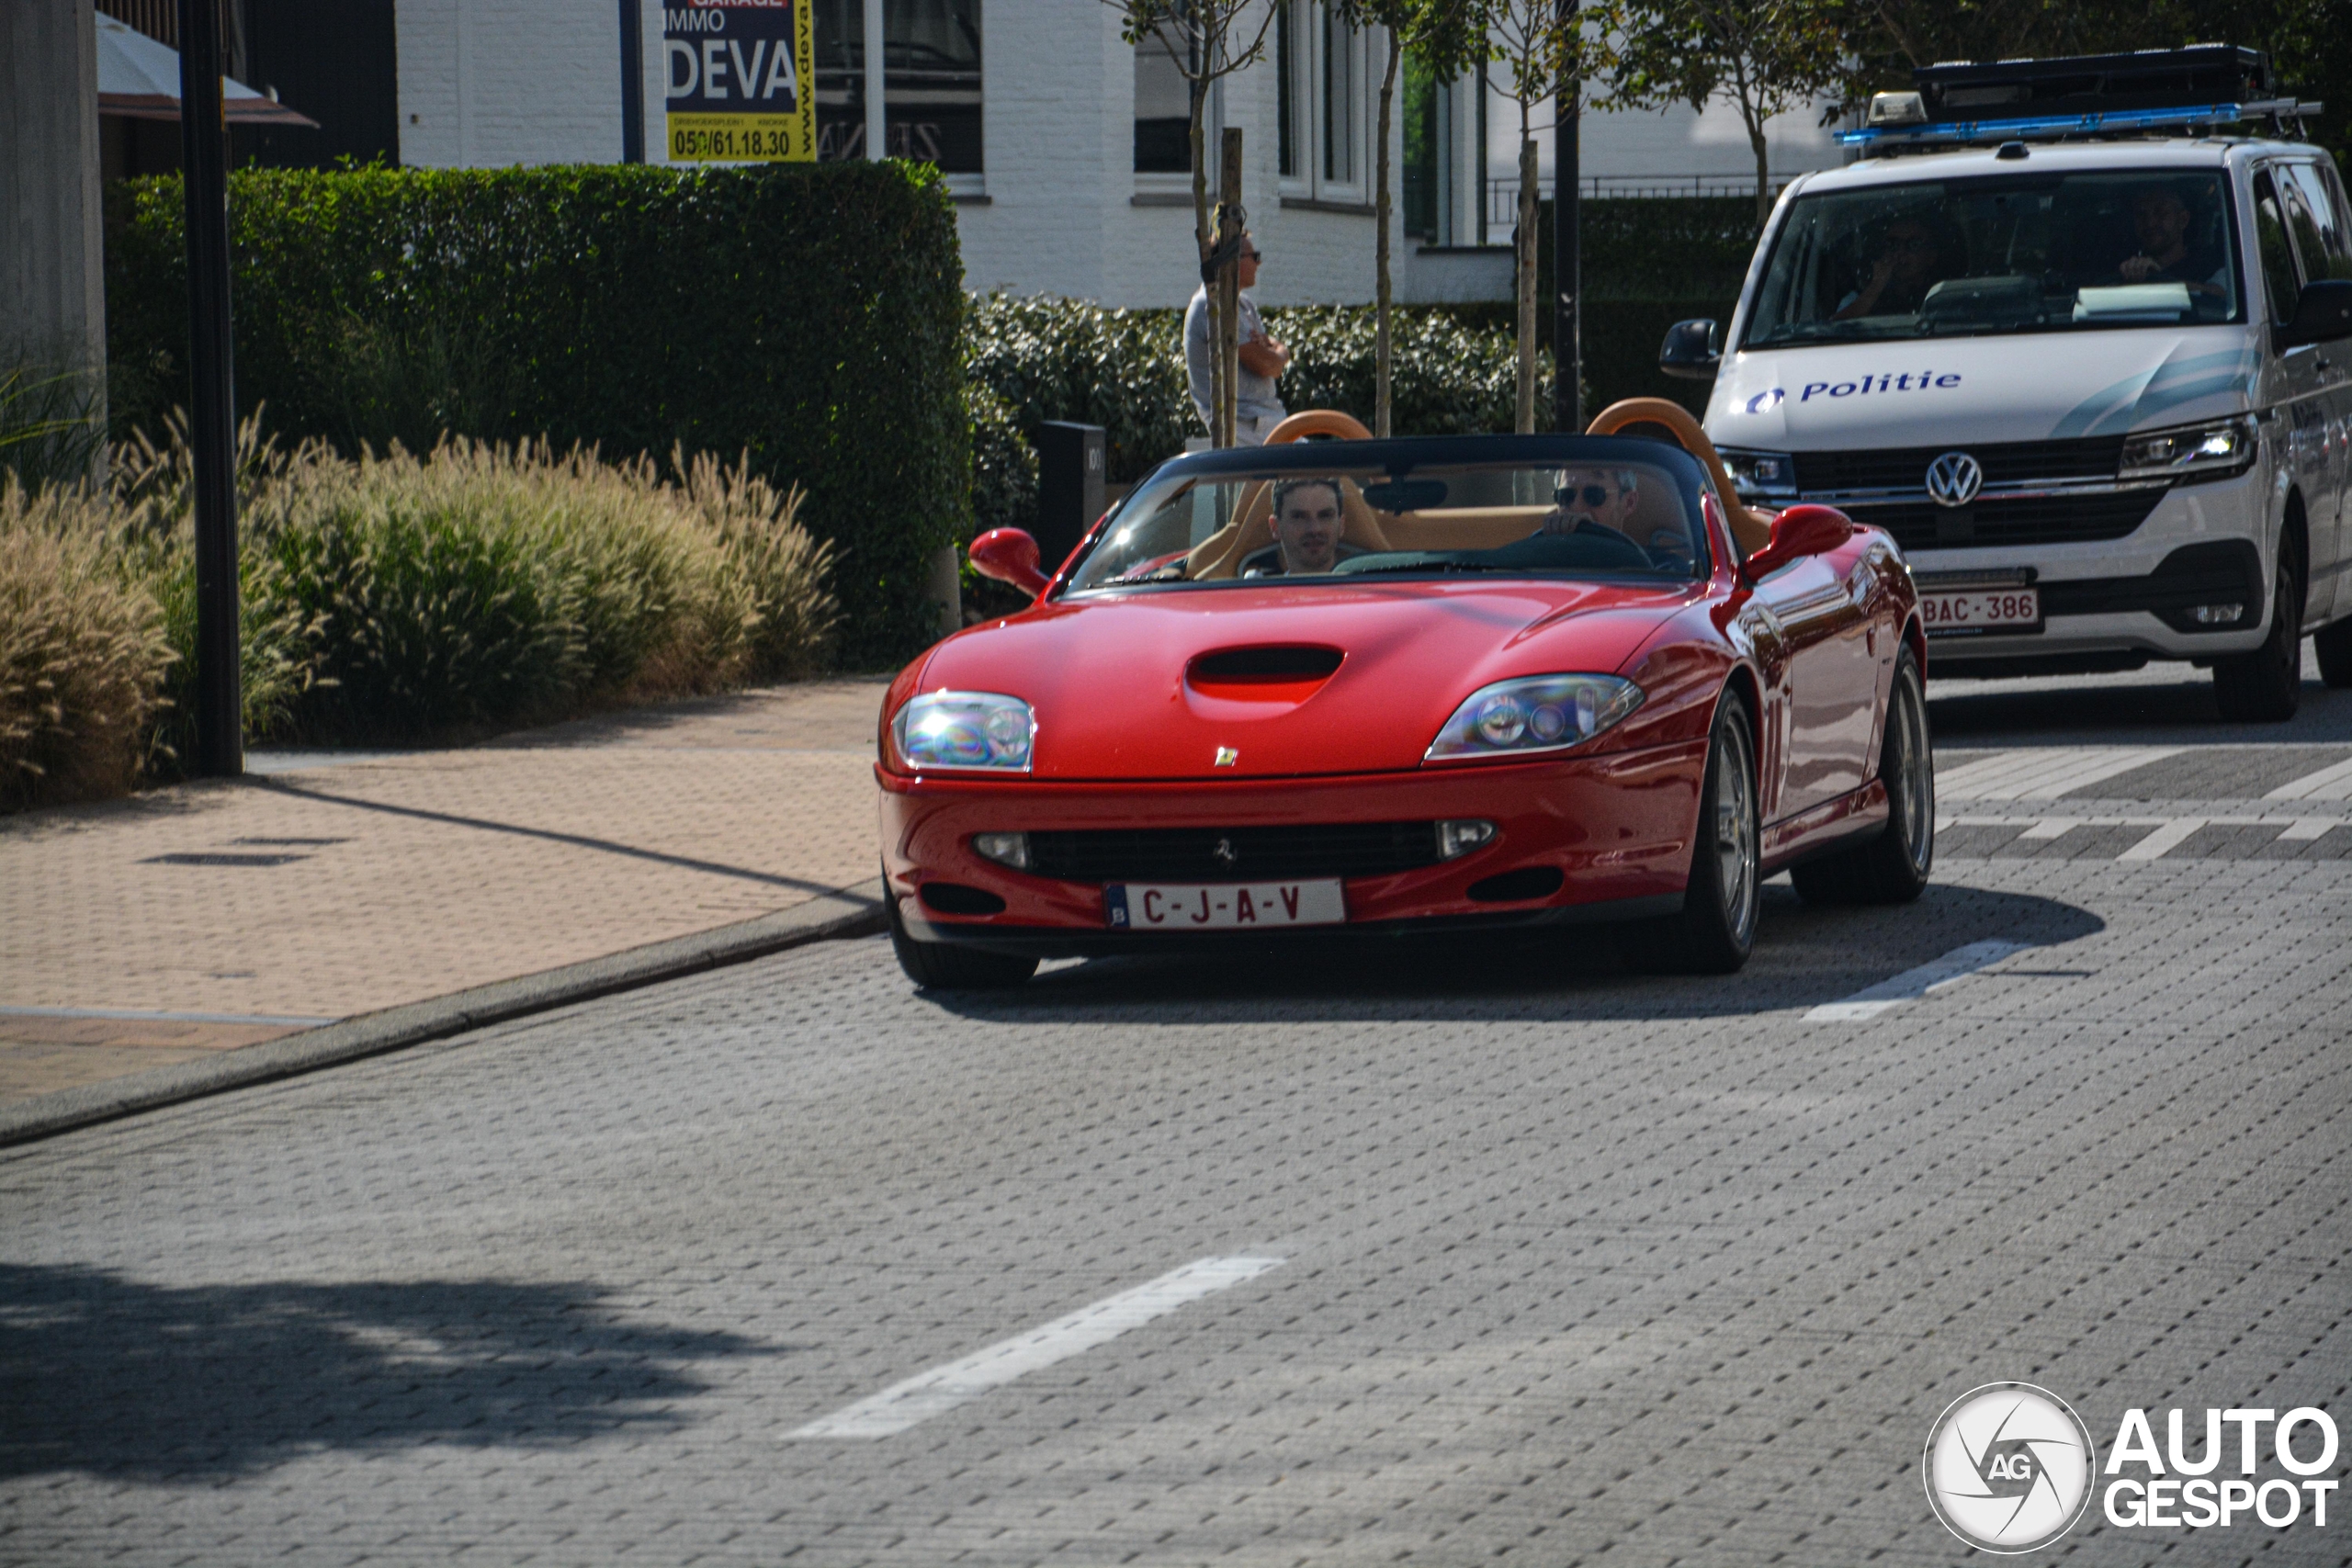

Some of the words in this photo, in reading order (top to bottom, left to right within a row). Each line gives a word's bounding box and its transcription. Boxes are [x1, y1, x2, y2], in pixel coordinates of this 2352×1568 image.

[663, 8, 726, 32] IMMO
[664, 39, 797, 99] DEVA
[1800, 370, 1962, 403] Politie
[1143, 886, 1299, 924] C-J-A-V
